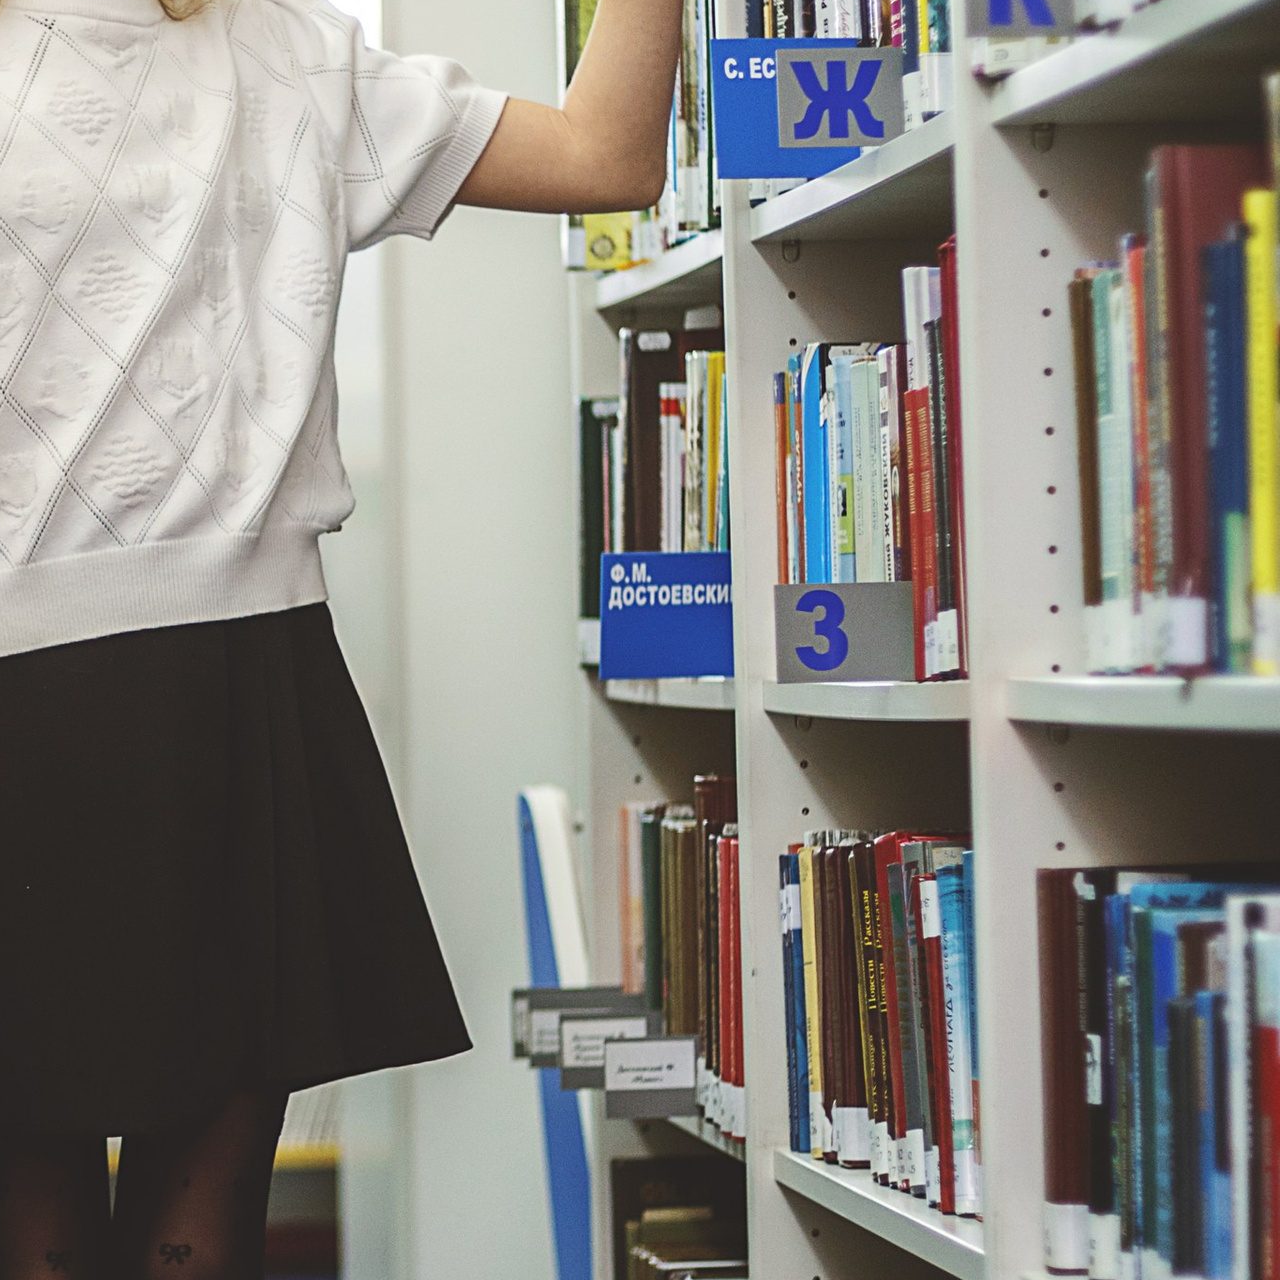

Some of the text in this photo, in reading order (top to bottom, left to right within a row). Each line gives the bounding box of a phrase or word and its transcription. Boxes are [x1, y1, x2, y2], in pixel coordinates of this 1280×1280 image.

[749, 58, 776, 79] ЕС
[789, 59, 884, 139] Ж
[608, 584, 732, 610] ДОСТОЕВСКИ
[862, 889, 873, 946] Рассказы
[867, 959, 877, 1010] Повести
